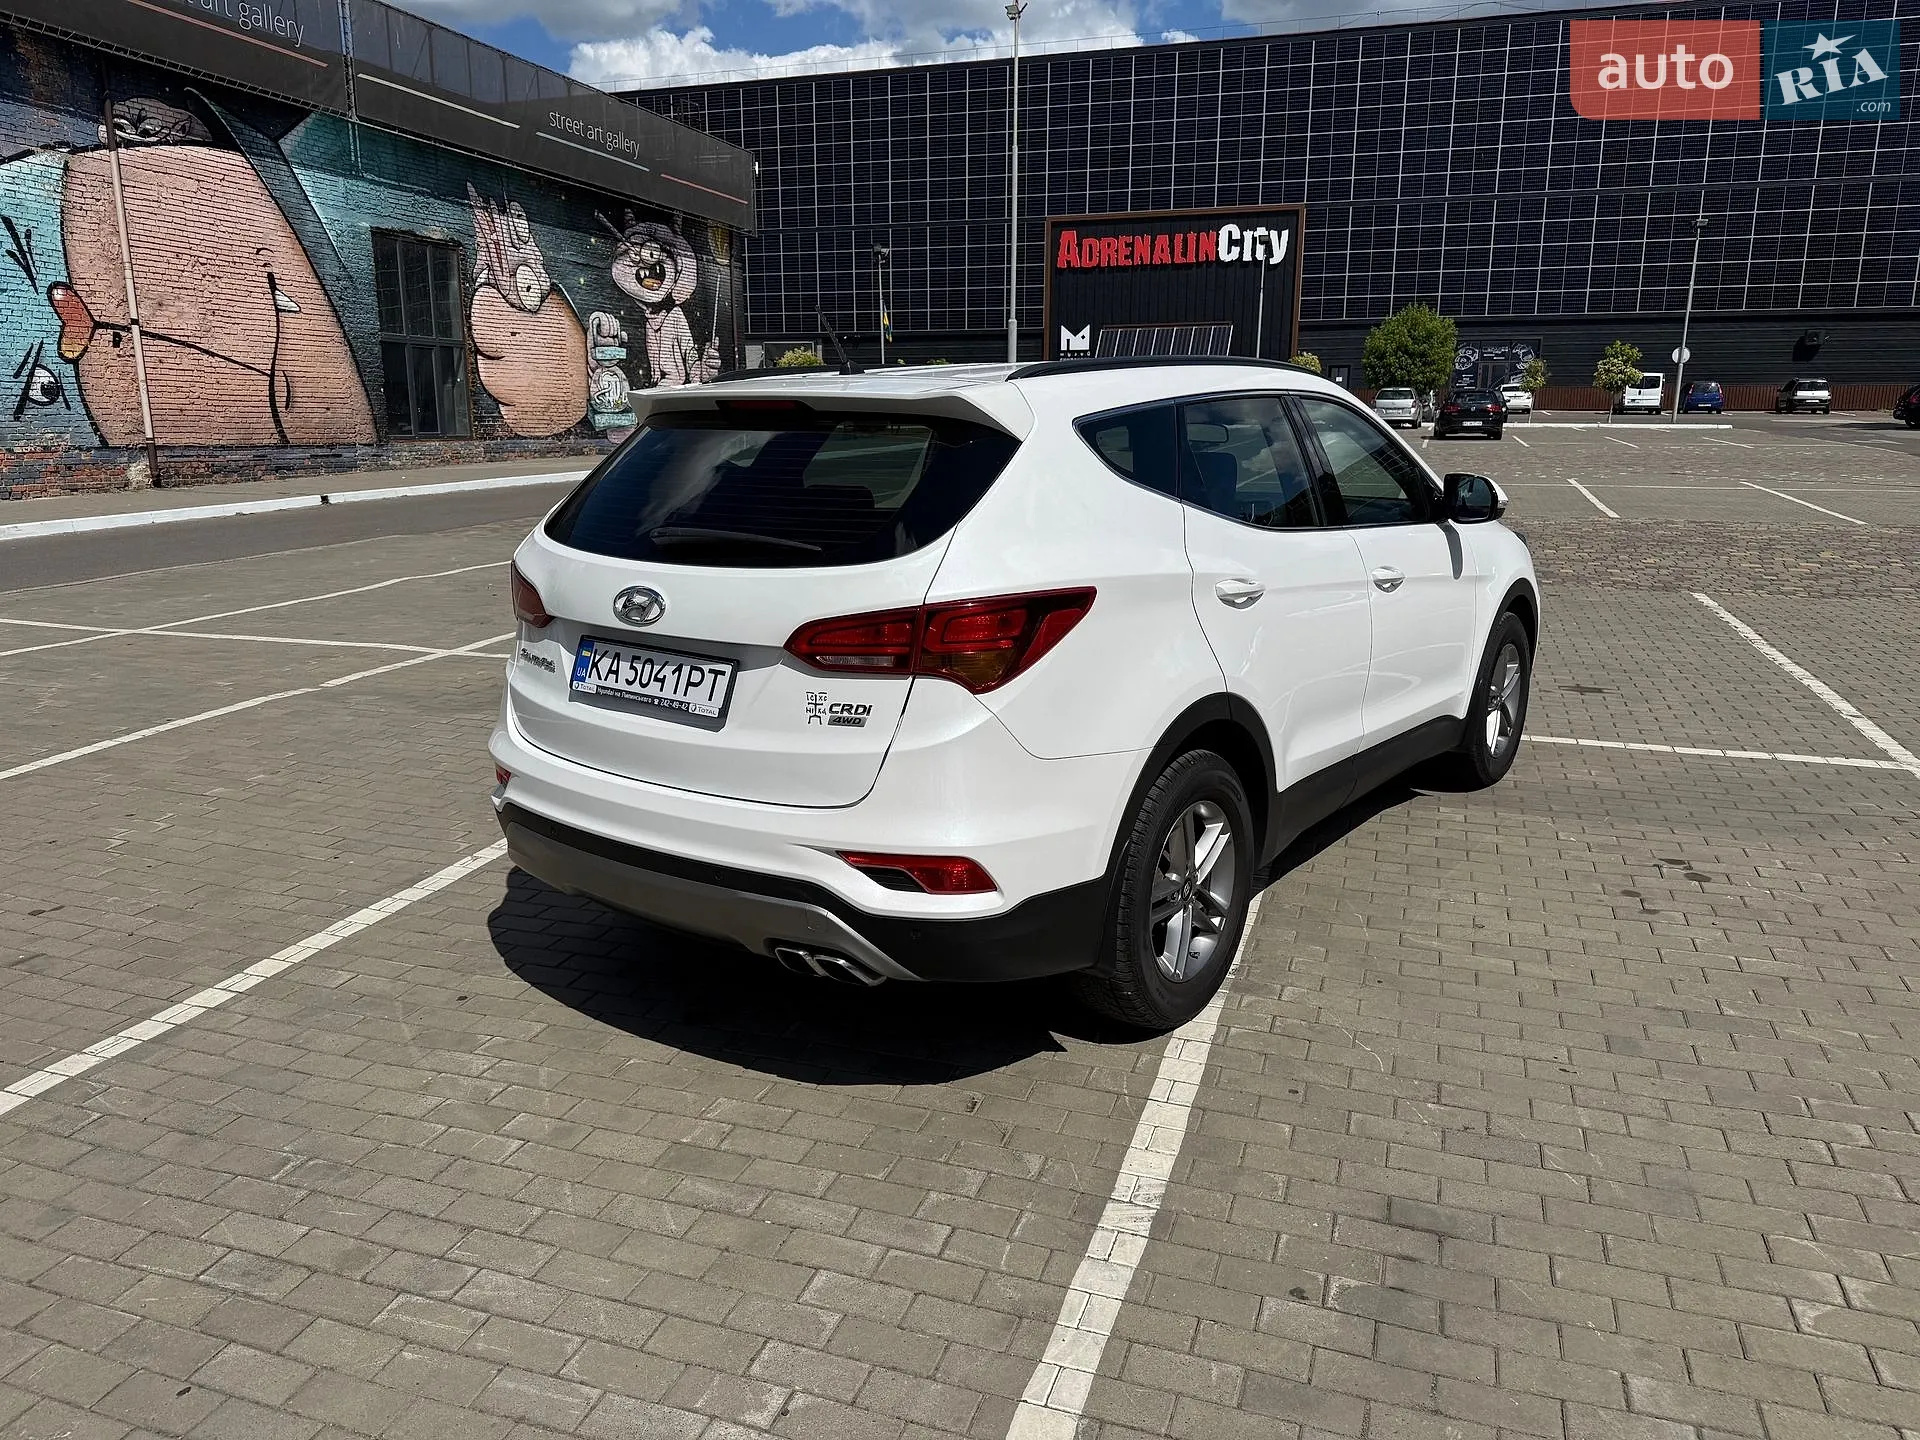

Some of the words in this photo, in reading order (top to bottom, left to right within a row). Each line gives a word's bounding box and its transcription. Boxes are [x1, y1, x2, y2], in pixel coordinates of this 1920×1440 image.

[238, 3, 304, 48] gallery
[549, 111, 585, 137] street
[587, 125, 605, 144] art
[606, 130, 640, 160] gallery
[576, 667, 586, 678] UA
[587, 648, 621, 684] KA
[597, 686, 615, 696] Hyundai
[828, 702, 873, 717] CRDI
[832, 716, 863, 725] 4WD
